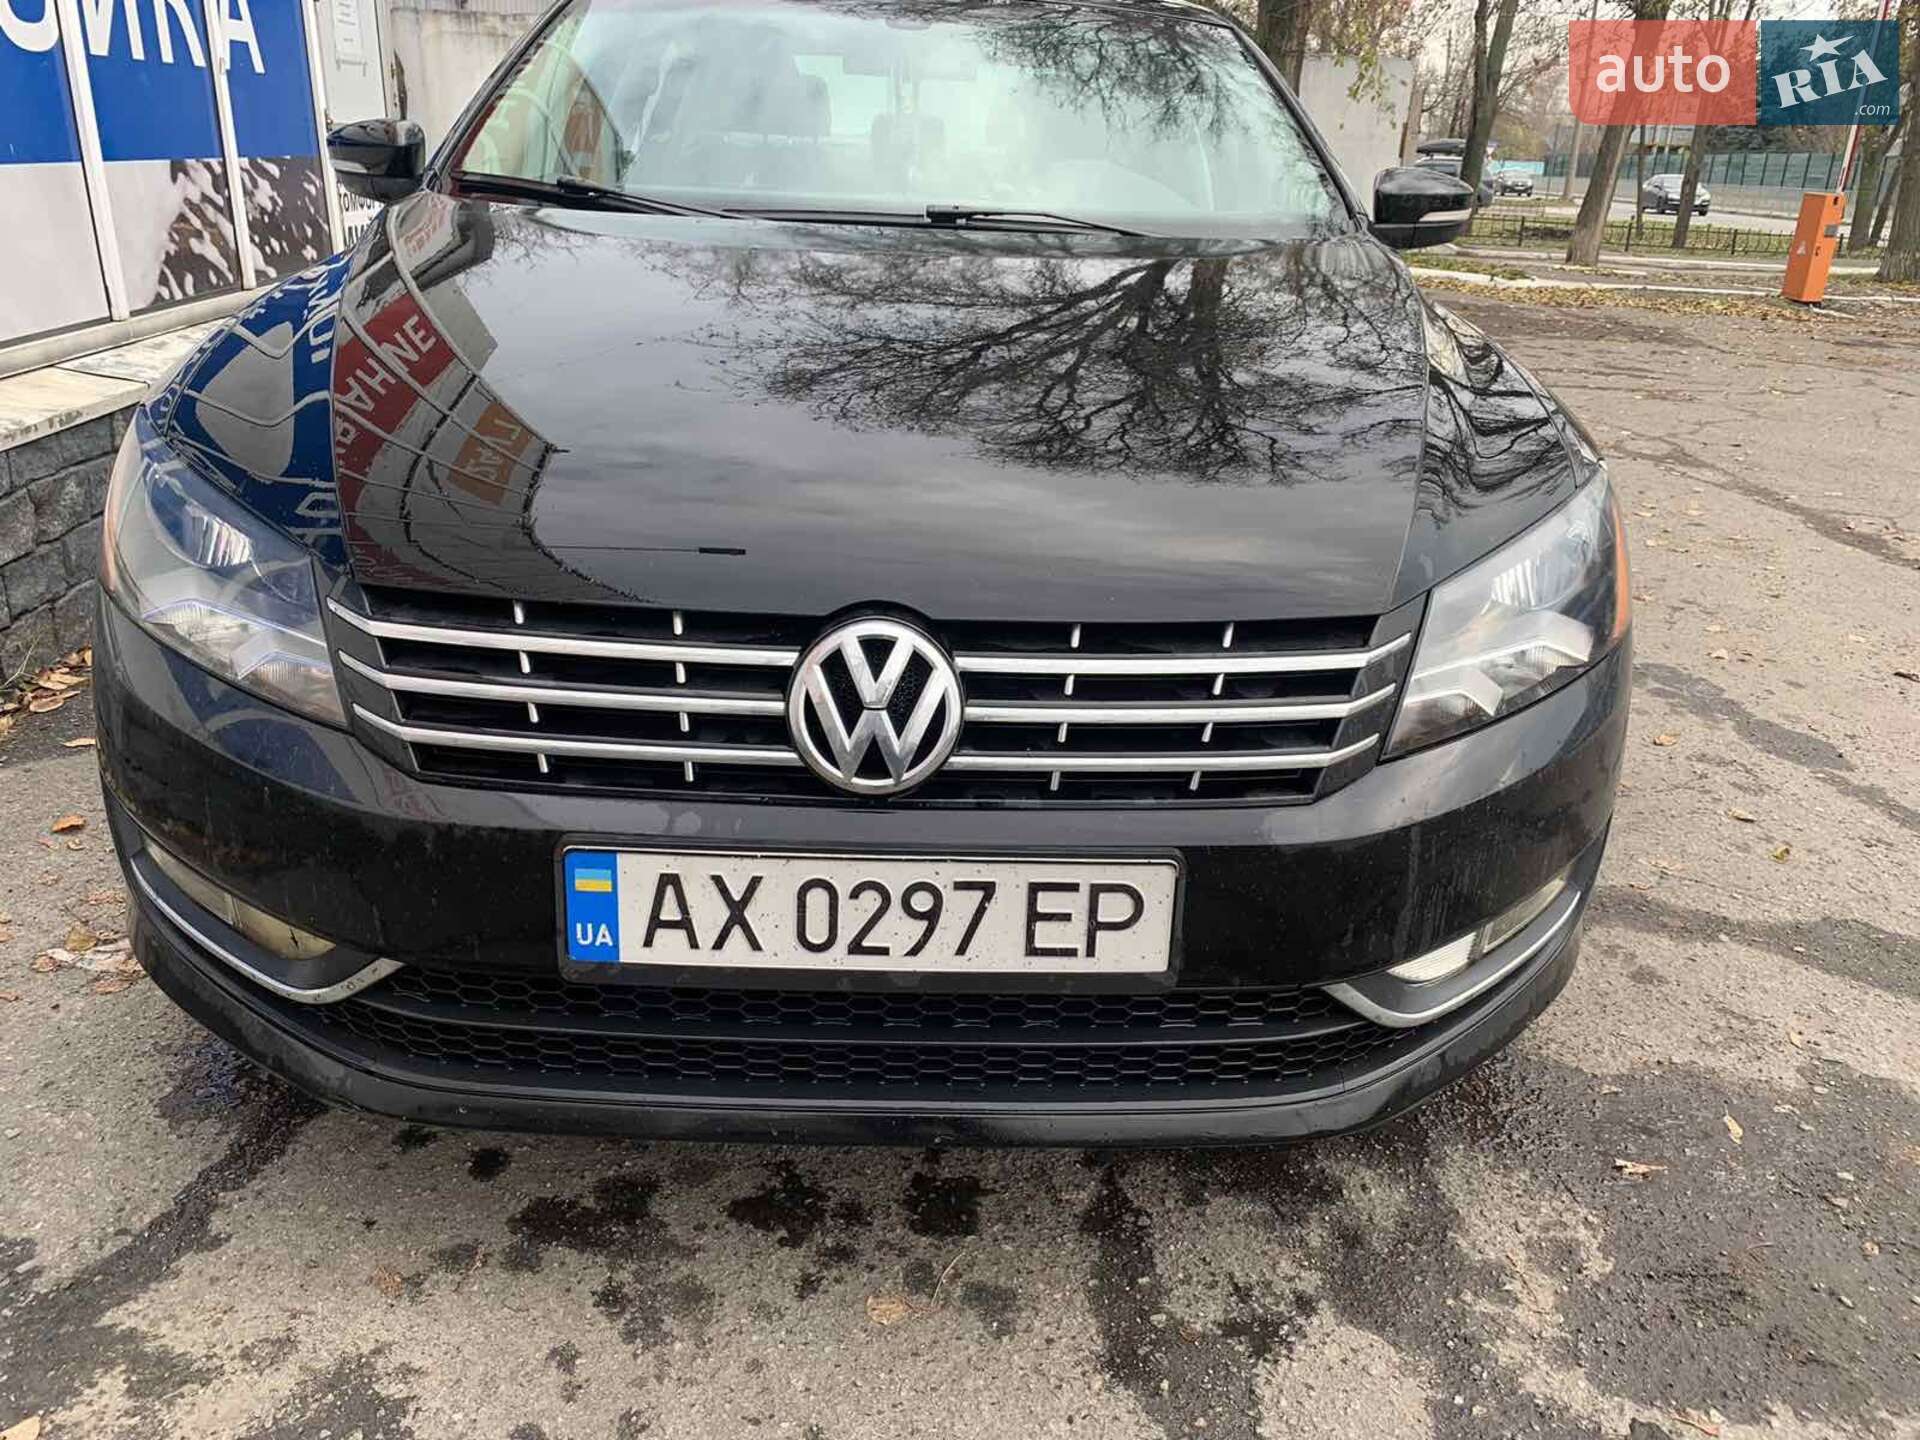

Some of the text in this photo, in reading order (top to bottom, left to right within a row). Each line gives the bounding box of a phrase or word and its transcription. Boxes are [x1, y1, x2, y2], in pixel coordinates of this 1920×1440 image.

[575, 922, 614, 948] UA
[641, 872, 1146, 959] AX 0297 EP
